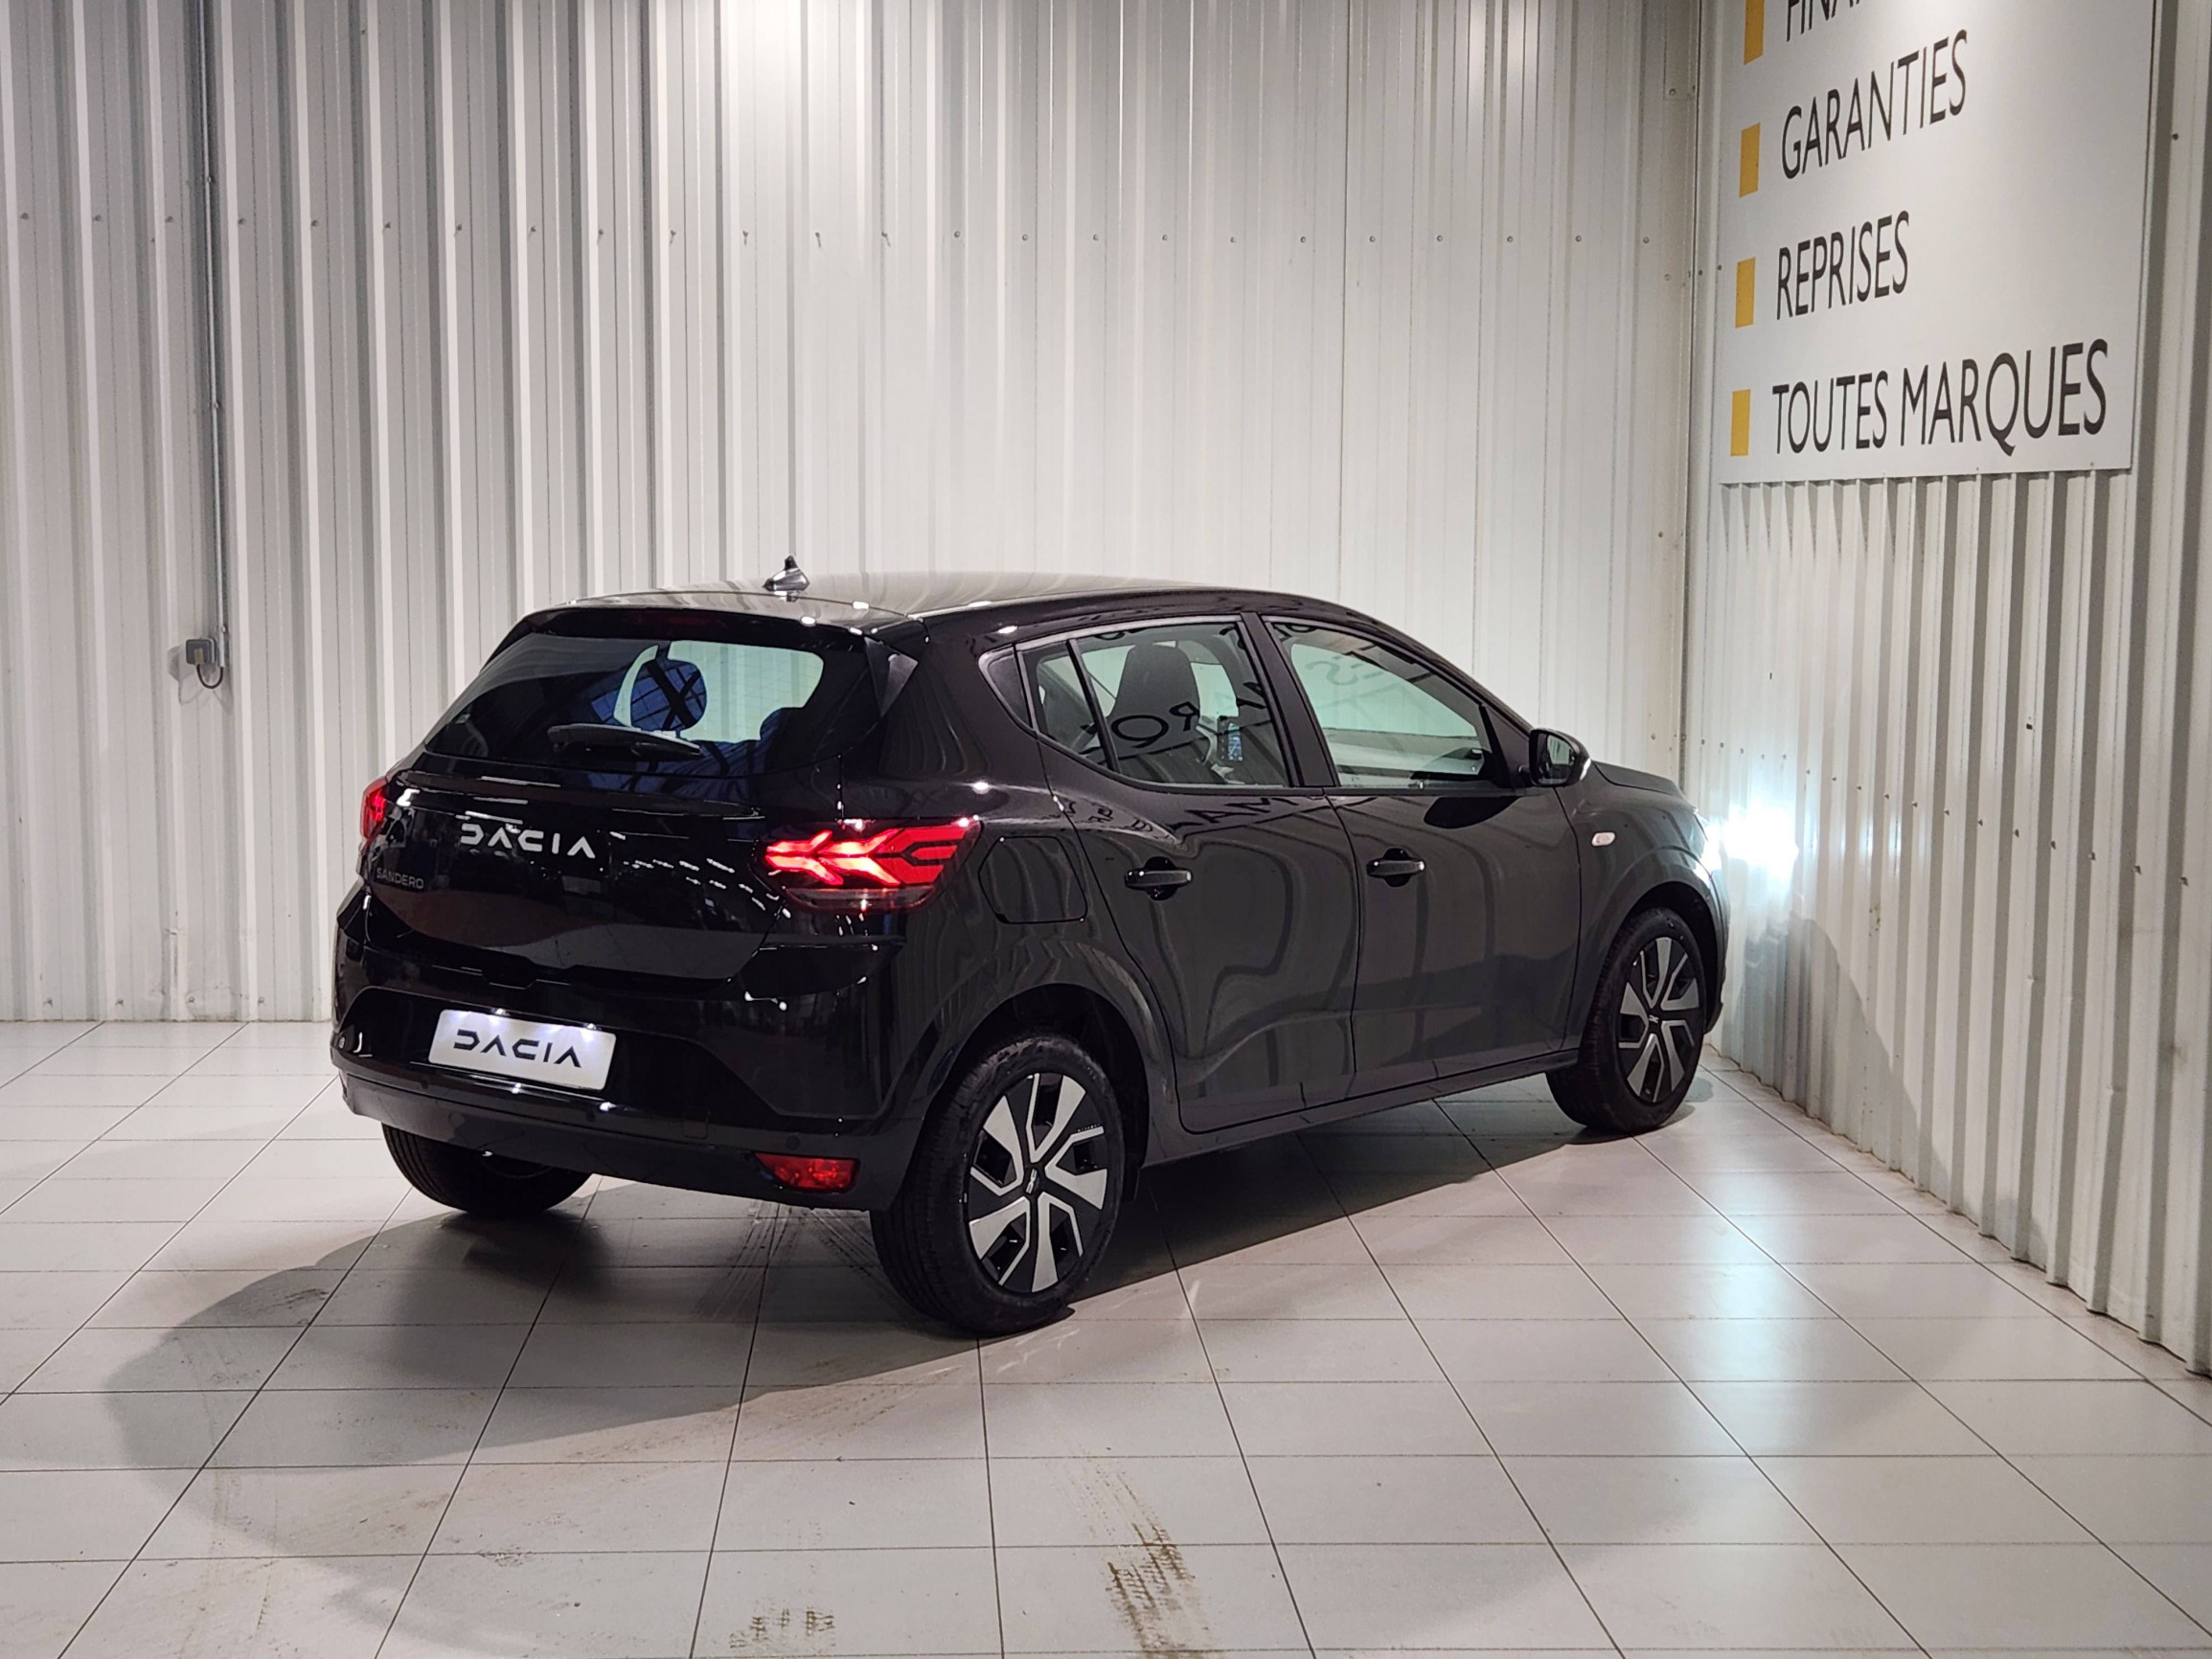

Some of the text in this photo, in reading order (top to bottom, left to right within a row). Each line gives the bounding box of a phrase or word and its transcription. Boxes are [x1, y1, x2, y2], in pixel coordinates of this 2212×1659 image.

[1781, 29, 1968, 180] GARANTIES
[1776, 210, 1910, 321] REPRISES
[1772, 338, 2108, 457] TOUTES MARQUES
[376, 867, 424, 890] SANDERO
[460, 822, 596, 859] DACIA
[452, 1028, 582, 1069] DACIA
